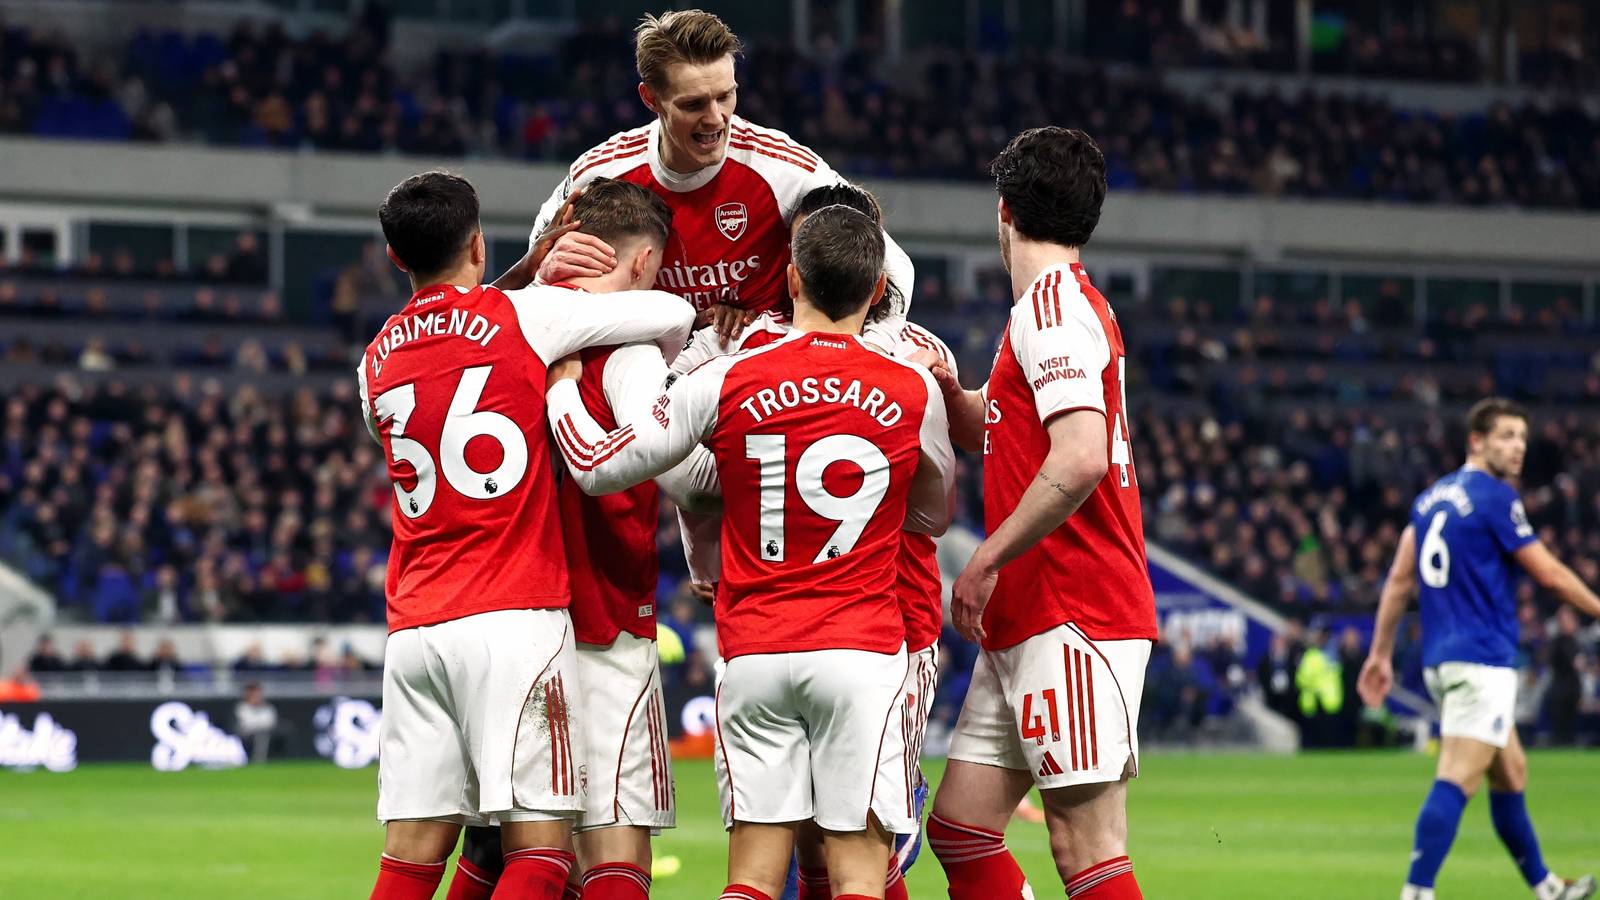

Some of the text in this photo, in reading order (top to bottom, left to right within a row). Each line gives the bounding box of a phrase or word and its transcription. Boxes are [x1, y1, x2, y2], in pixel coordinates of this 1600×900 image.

[720, 209, 744, 217] Arsenal
[656, 254, 761, 289] mirates
[415, 291, 445, 308] Arsenal
[371, 308, 501, 378] ZUBIMENDI
[810, 337, 847, 350] Arsenal
[1038, 356, 1070, 373] VISIT
[1033, 368, 1087, 393] RWANDA
[739, 377, 903, 428] TROSSARD
[373, 365, 529, 519] 36
[745, 433, 891, 565] 19
[1419, 510, 1450, 588] 6
[1021, 688, 1061, 746] 41
